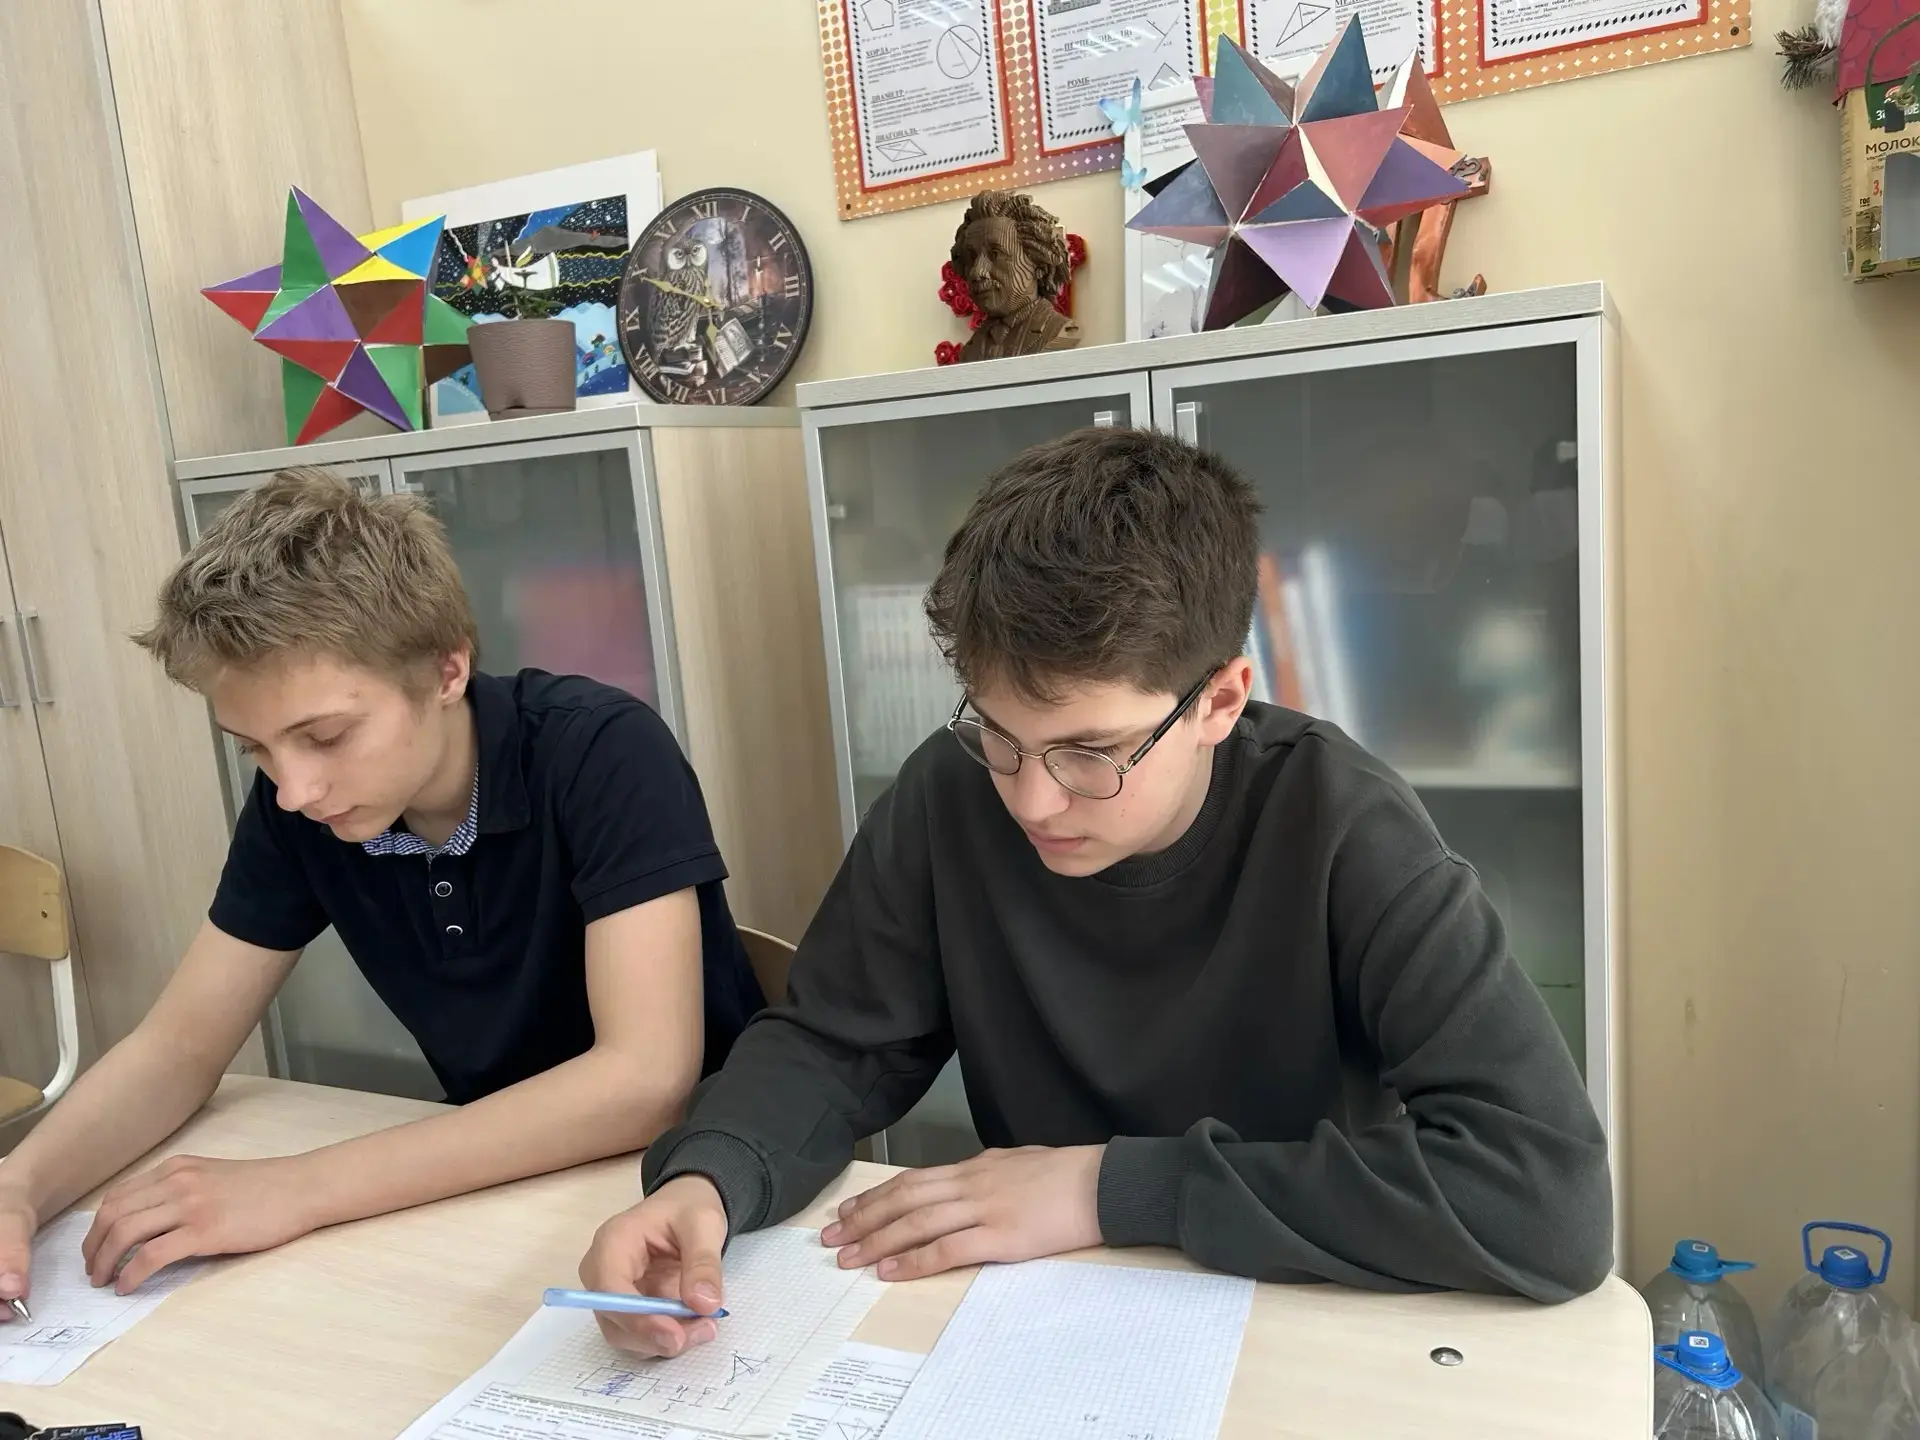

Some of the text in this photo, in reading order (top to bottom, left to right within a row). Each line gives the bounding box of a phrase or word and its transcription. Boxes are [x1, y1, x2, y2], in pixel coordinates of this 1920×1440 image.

[866, 47, 891, 58] ХОРДА
[1067, 77, 1090, 88] РОМБ
[871, 89, 905, 102] ДИАМЕТР
[875, 128, 919, 142] ДИАГОНАЛЬ
[784, 275, 800, 299] III
[707, 388, 728, 405] VI
